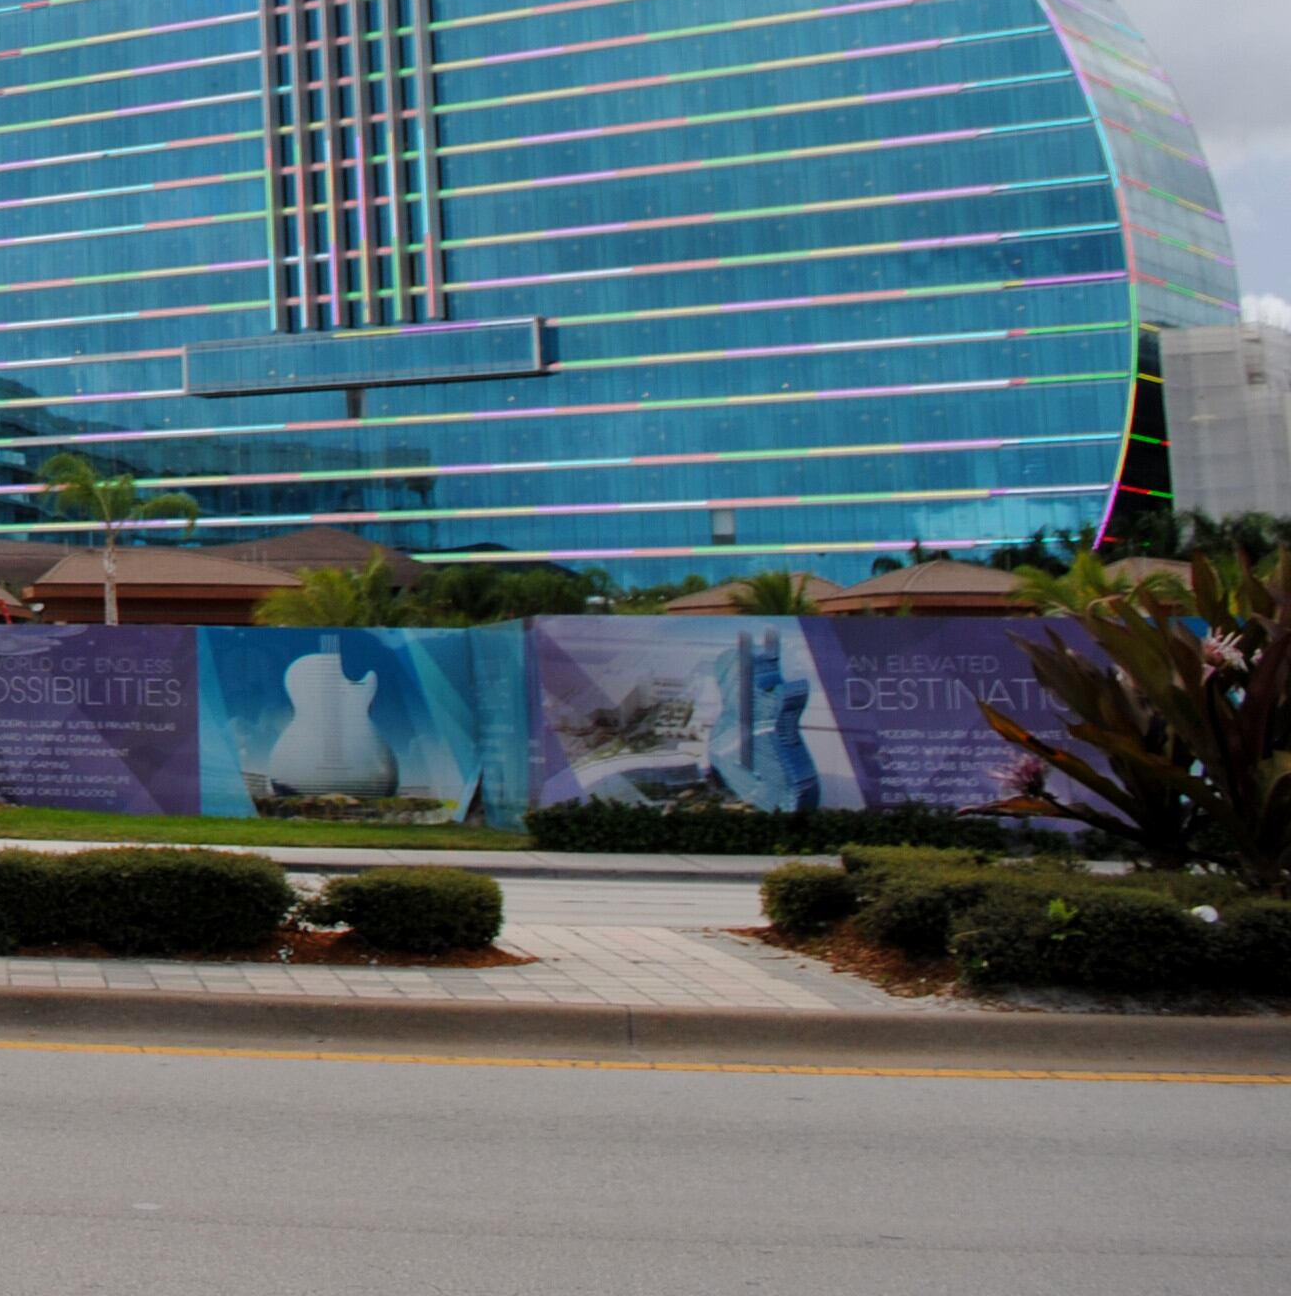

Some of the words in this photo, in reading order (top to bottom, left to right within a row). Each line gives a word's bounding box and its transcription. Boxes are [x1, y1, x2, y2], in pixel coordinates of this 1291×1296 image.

[62, 658, 87, 673] OF
[95, 658, 173, 674] ENDLESS
[846, 655, 877, 672] AN
[886, 655, 999, 673] ELEVATED
